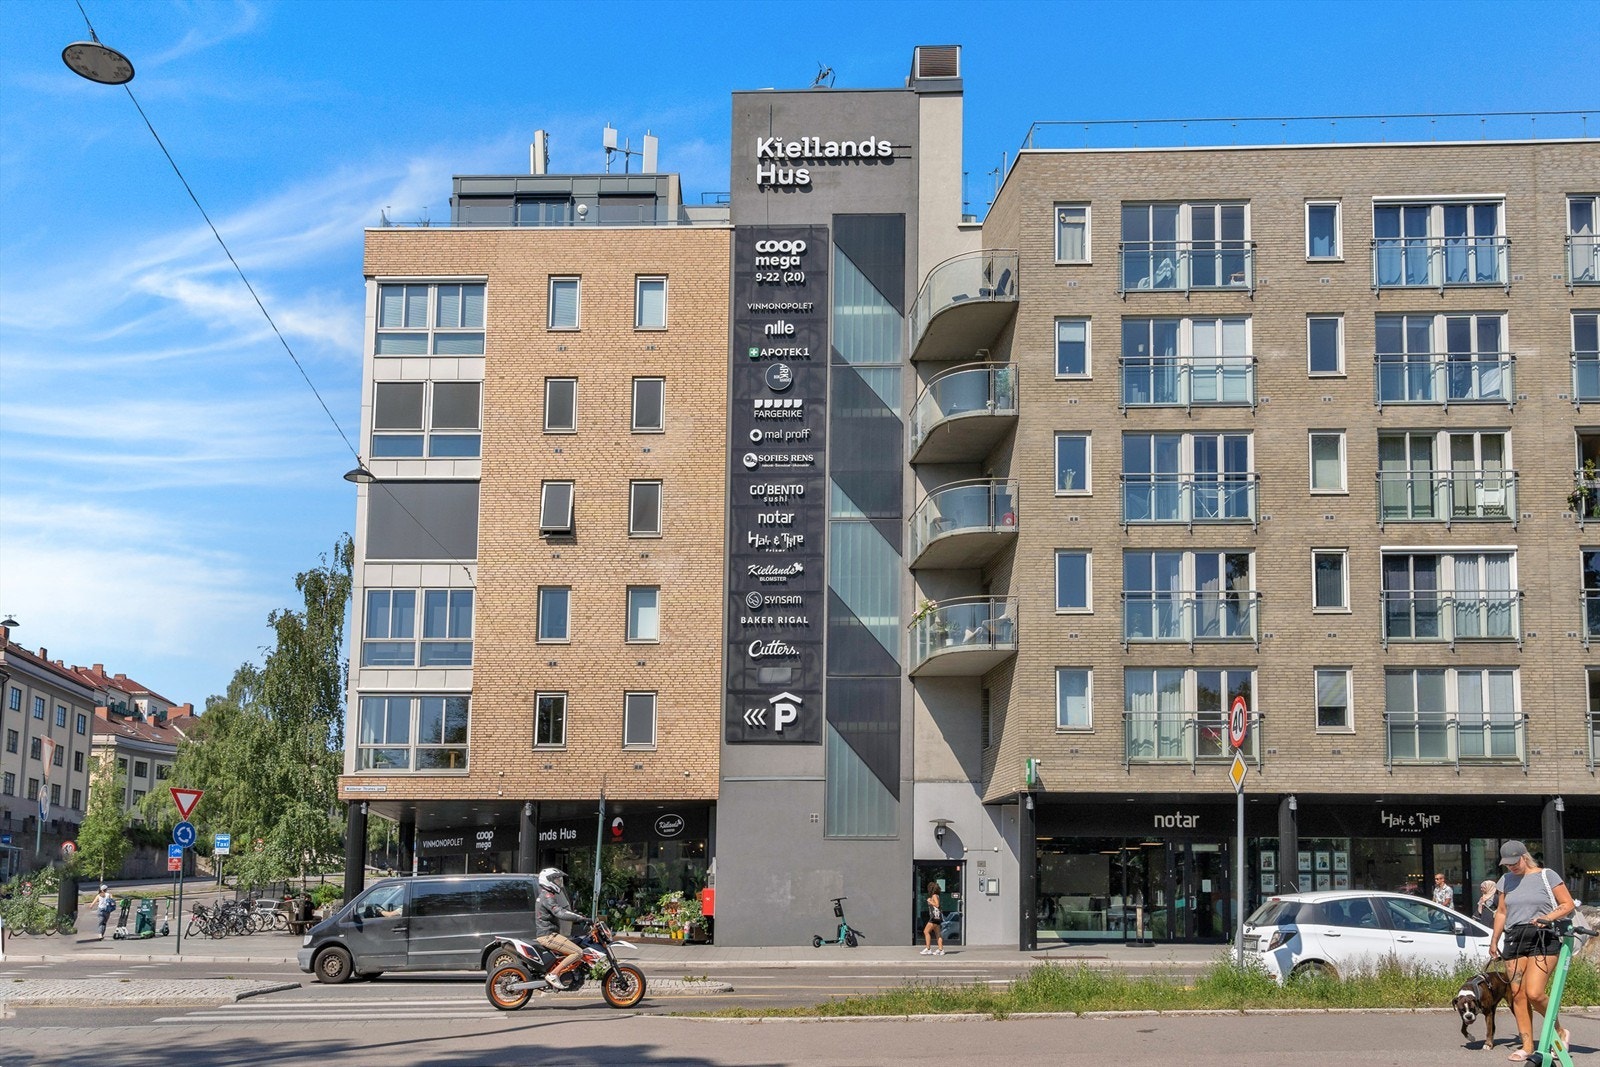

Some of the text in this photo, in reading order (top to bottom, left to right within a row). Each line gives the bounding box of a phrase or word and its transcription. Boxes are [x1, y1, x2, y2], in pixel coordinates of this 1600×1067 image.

[756, 135, 893, 158] Kiellands
[756, 163, 811, 185] Hus
[755, 239, 806, 255] coop
[755, 255, 801, 270] mega
[755, 272, 805, 283] 9-22 (20)
[747, 302, 813, 310] VINMONOPOLET
[764, 320, 795, 335] nille
[760, 347, 810, 357] APOTEK 1
[753, 409, 803, 418] FARGERIKE
[764, 428, 812, 441] mal proff
[758, 454, 814, 462] SOFIES RENS
[757, 510, 795, 524] notar
[748, 531, 772, 548] Hair
[773, 535, 780, 546] &
[747, 563, 798, 576] Kiellands
[740, 616, 809, 624] BAKER RIGAL
[1232, 708, 1244, 734] 40
[1154, 811, 1200, 828] notar
[1381, 810, 1406, 828] Hair
[1408, 815, 1416, 826] &
[476, 831, 494, 841] coop
[559, 827, 577, 840] Hus
[423, 837, 464, 848] VINMONOPOLET
[476, 841, 492, 851] mega
